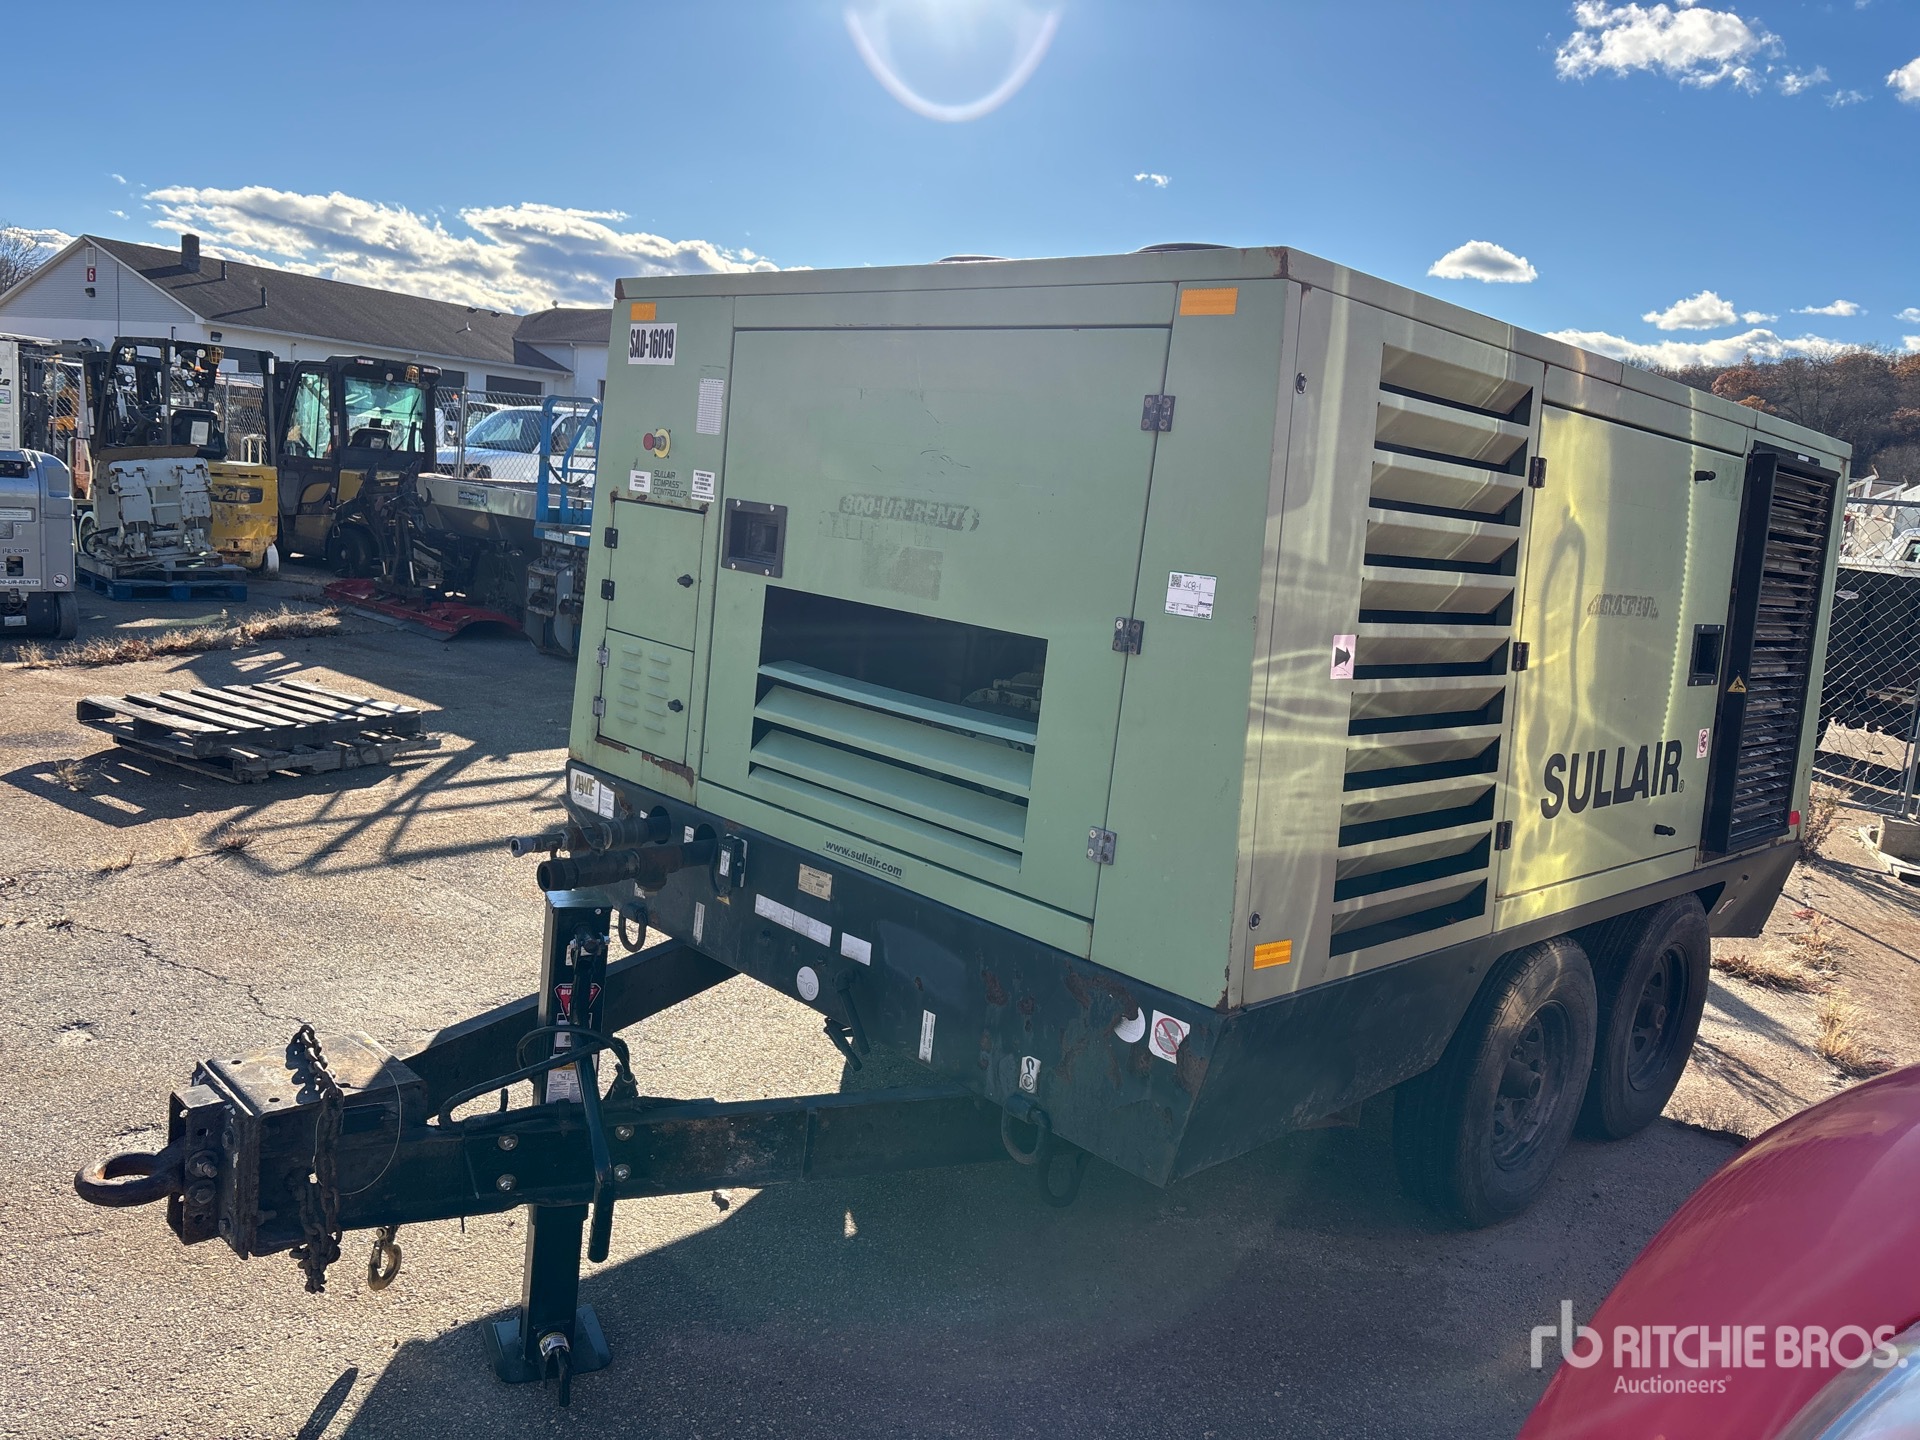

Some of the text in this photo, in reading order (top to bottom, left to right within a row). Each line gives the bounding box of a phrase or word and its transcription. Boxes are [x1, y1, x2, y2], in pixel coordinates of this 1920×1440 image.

[89, 269, 94, 281] 6
[630, 328, 674, 359] SAD-16019
[653, 469, 676, 479] SULLAIR
[215, 486, 251, 502] Yale
[652, 487, 688, 498] CONTROLLER
[825, 840, 902, 877] www.sullair.com
